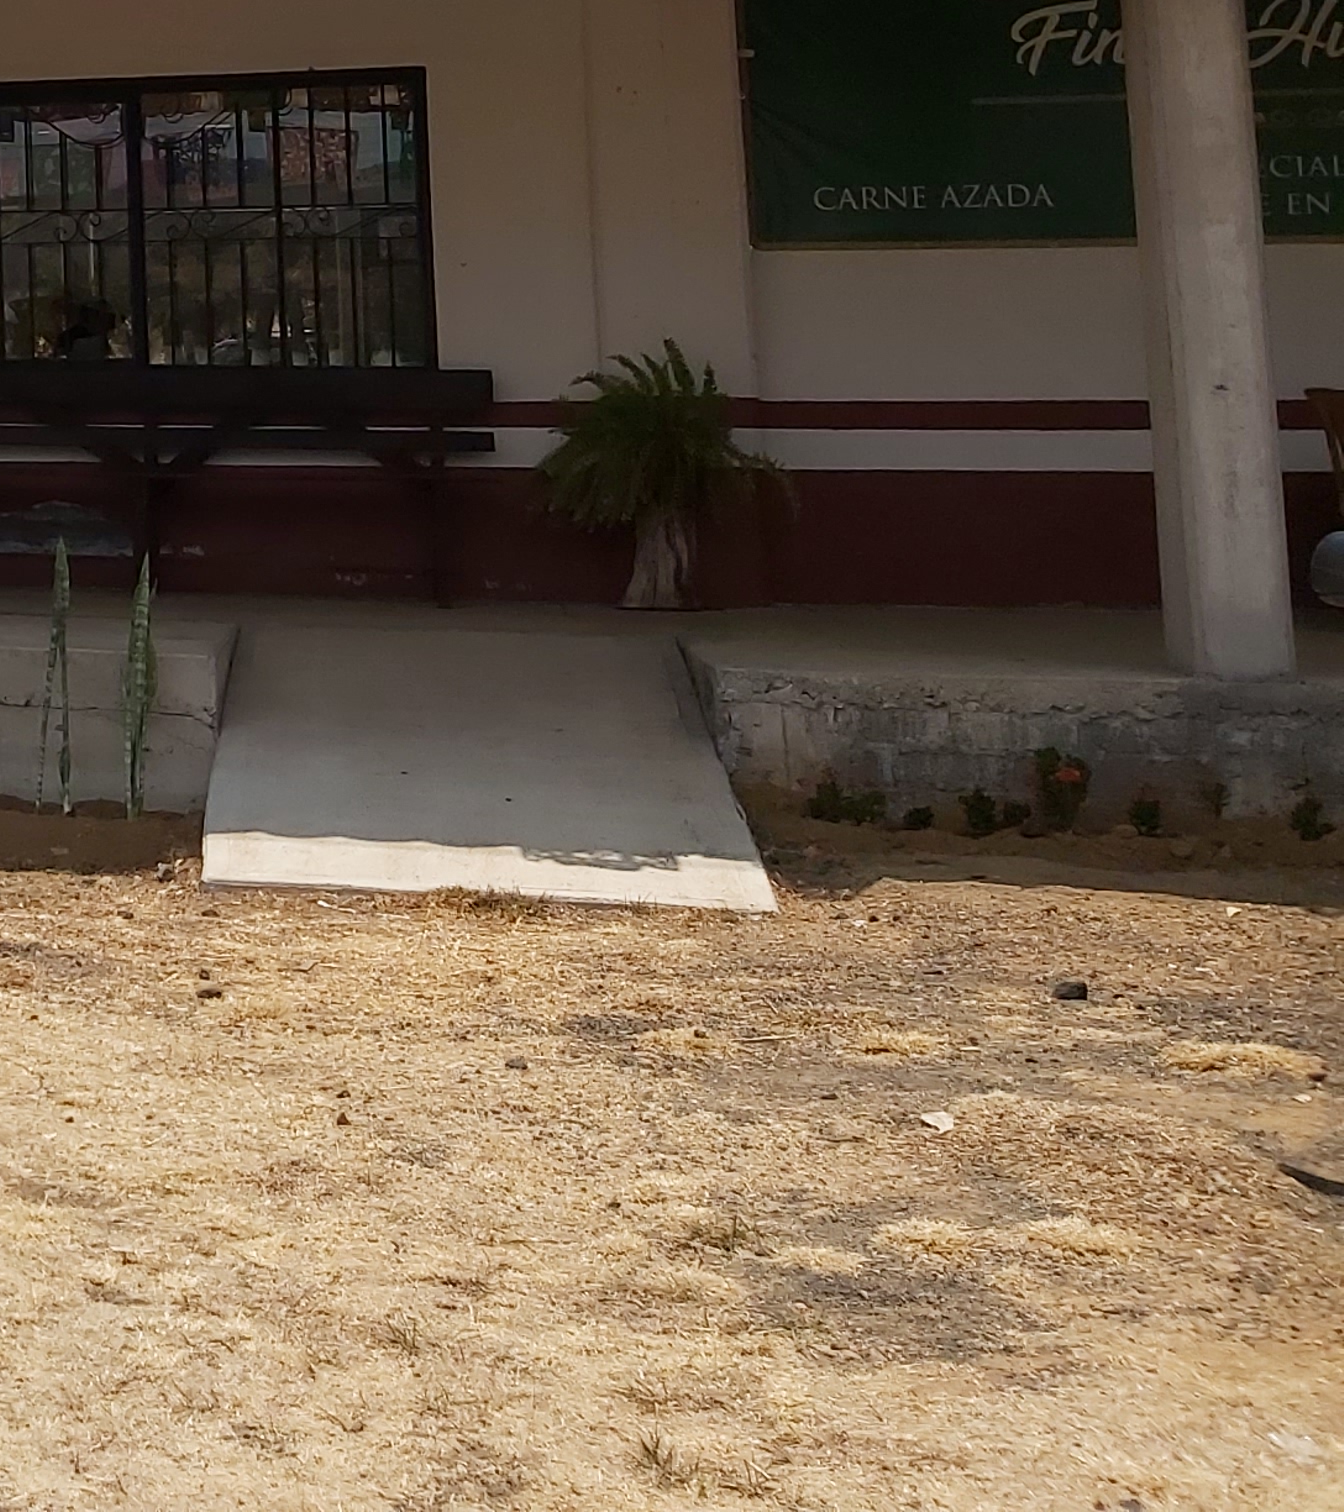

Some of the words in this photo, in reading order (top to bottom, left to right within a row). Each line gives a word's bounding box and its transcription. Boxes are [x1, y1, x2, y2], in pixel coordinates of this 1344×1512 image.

[1259, 154, 1344, 179] CIAL
[813, 186, 927, 211] CARNE
[940, 183, 1055, 209] AZADA
[1287, 192, 1330, 216] EN
